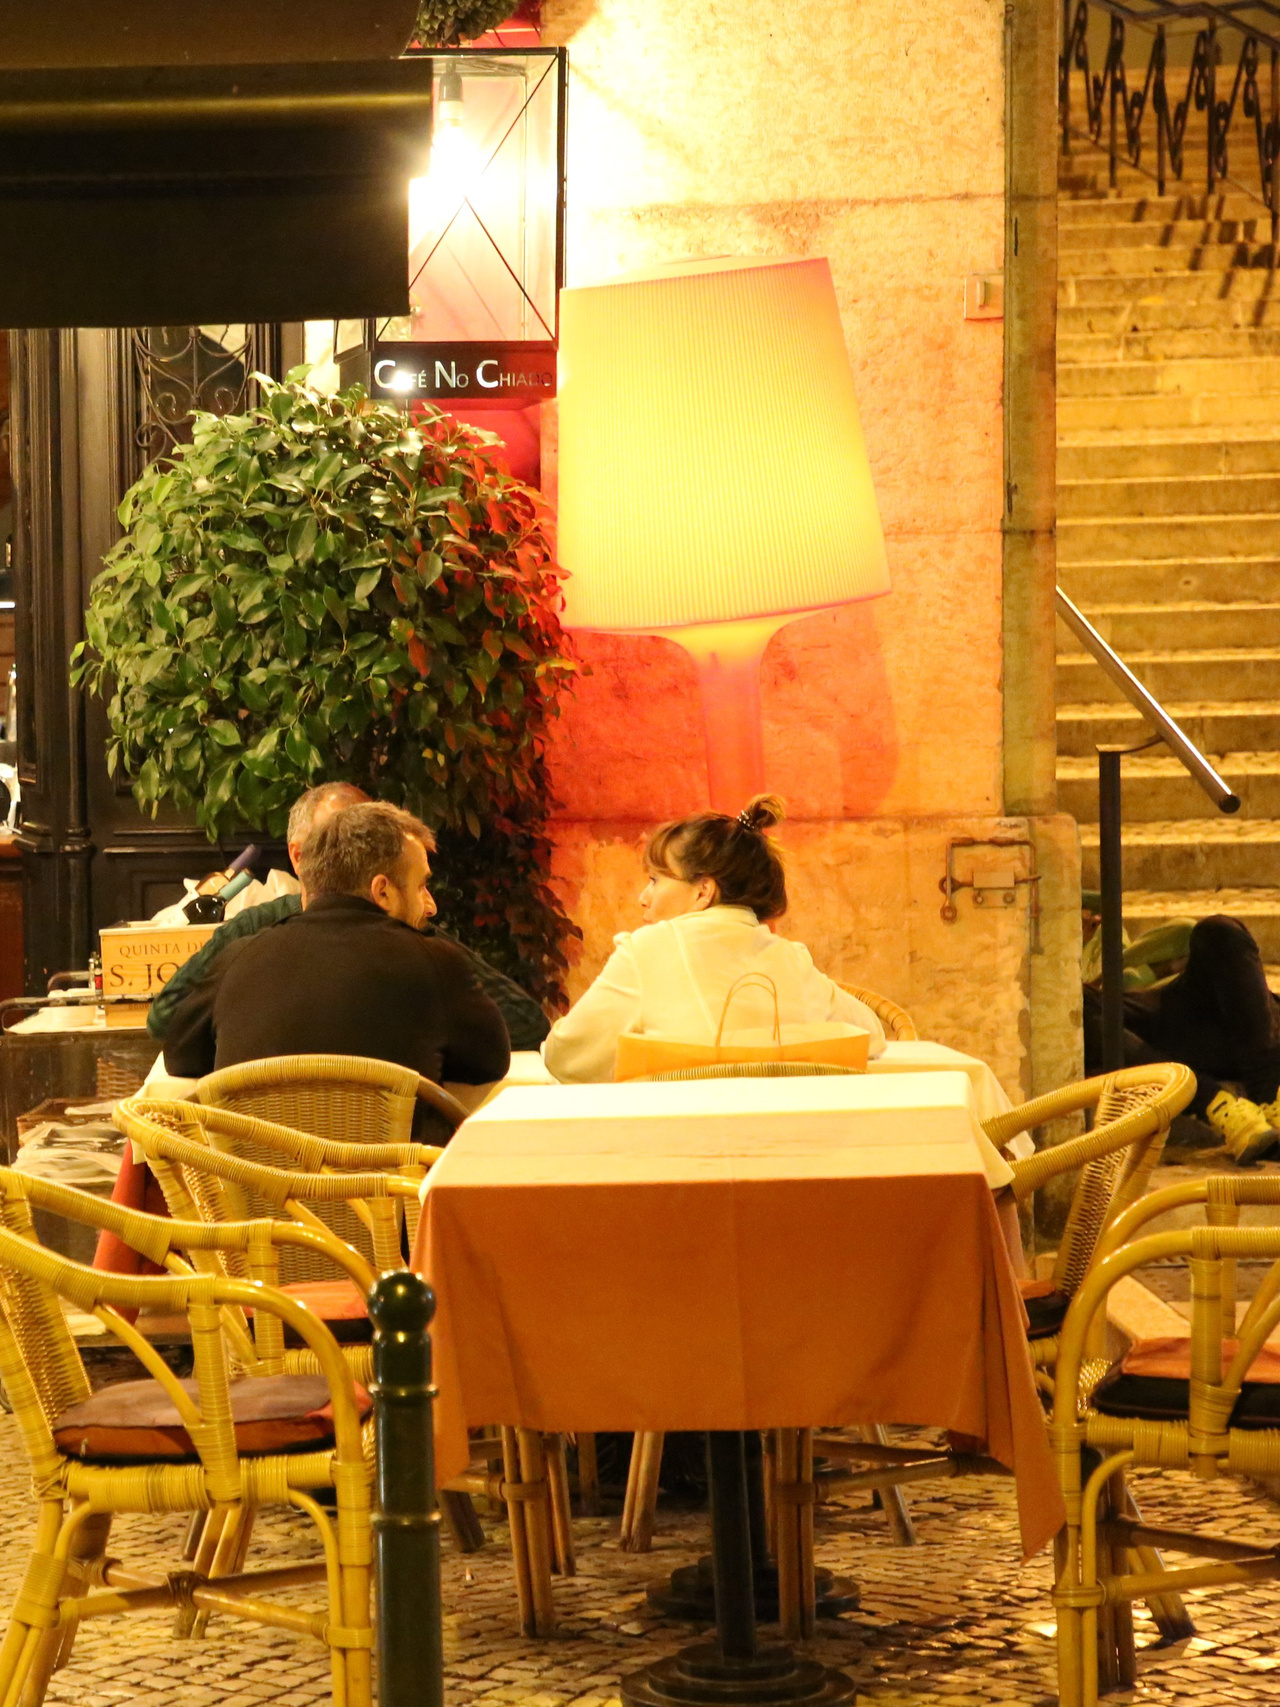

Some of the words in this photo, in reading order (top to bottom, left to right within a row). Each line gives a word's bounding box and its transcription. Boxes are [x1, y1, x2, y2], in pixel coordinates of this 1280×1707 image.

[373, 359, 428, 389] CFÉ
[475, 359, 554, 389] CHIADO
[119, 942, 181, 959] QUINTA
[109, 964, 133, 988] S.
